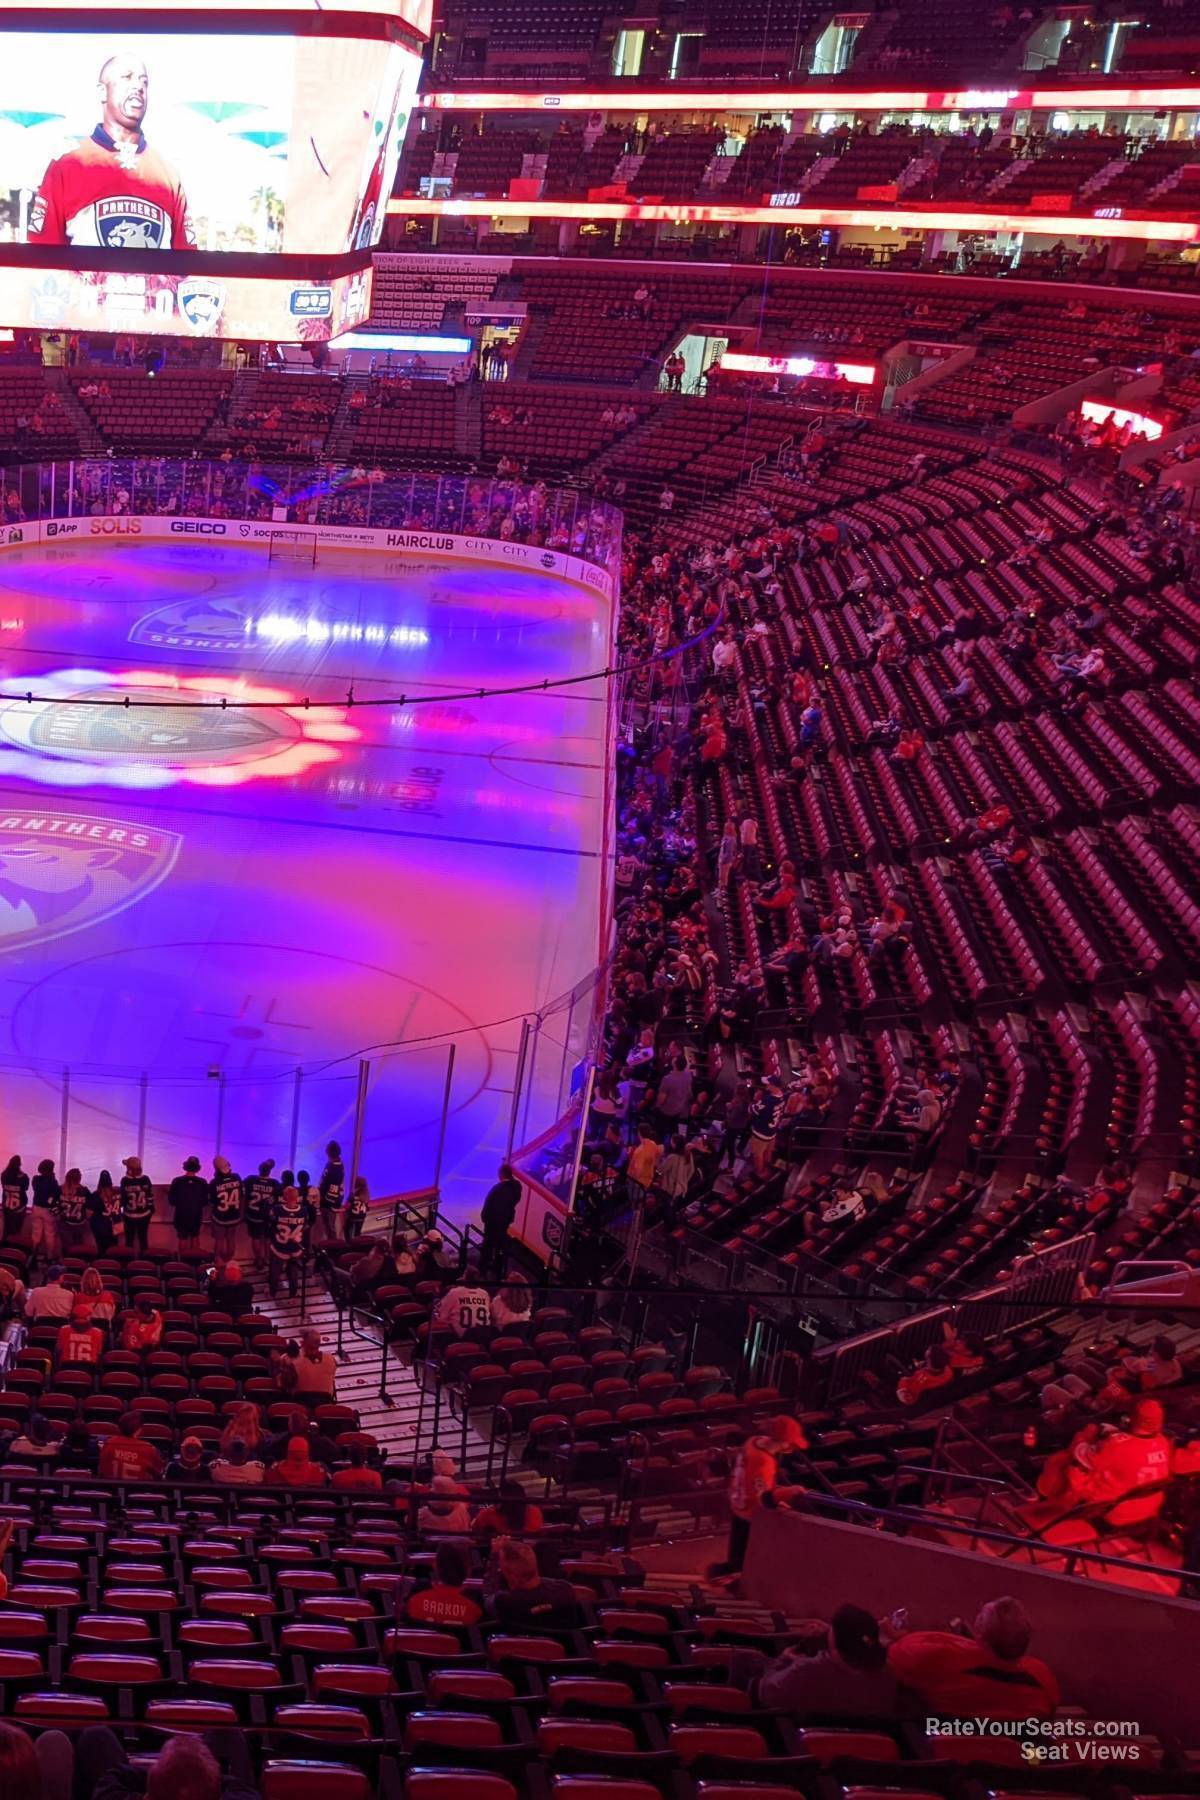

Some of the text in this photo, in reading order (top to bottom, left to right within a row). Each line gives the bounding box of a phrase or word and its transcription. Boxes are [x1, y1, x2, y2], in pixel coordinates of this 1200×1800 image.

[102, 201, 158, 219] PANTHERS
[467, 317, 481, 325] 109
[90, 518, 142, 534] SOLIS
[170, 521, 227, 535] GEICO
[386, 534, 454, 550] HAIRCLUB
[465, 540, 494, 551] CITY
[503, 545, 529, 557] CITY
[128, 1190, 146, 1211] 34
[217, 1189, 240, 1212] 34
[352, 1201, 367, 1215] 34
[276, 1225, 304, 1244] 34
[459, 1297, 486, 1305] WILCOX
[460, 1306, 487, 1328] 09
[423, 1599, 466, 1617] BARKOV
